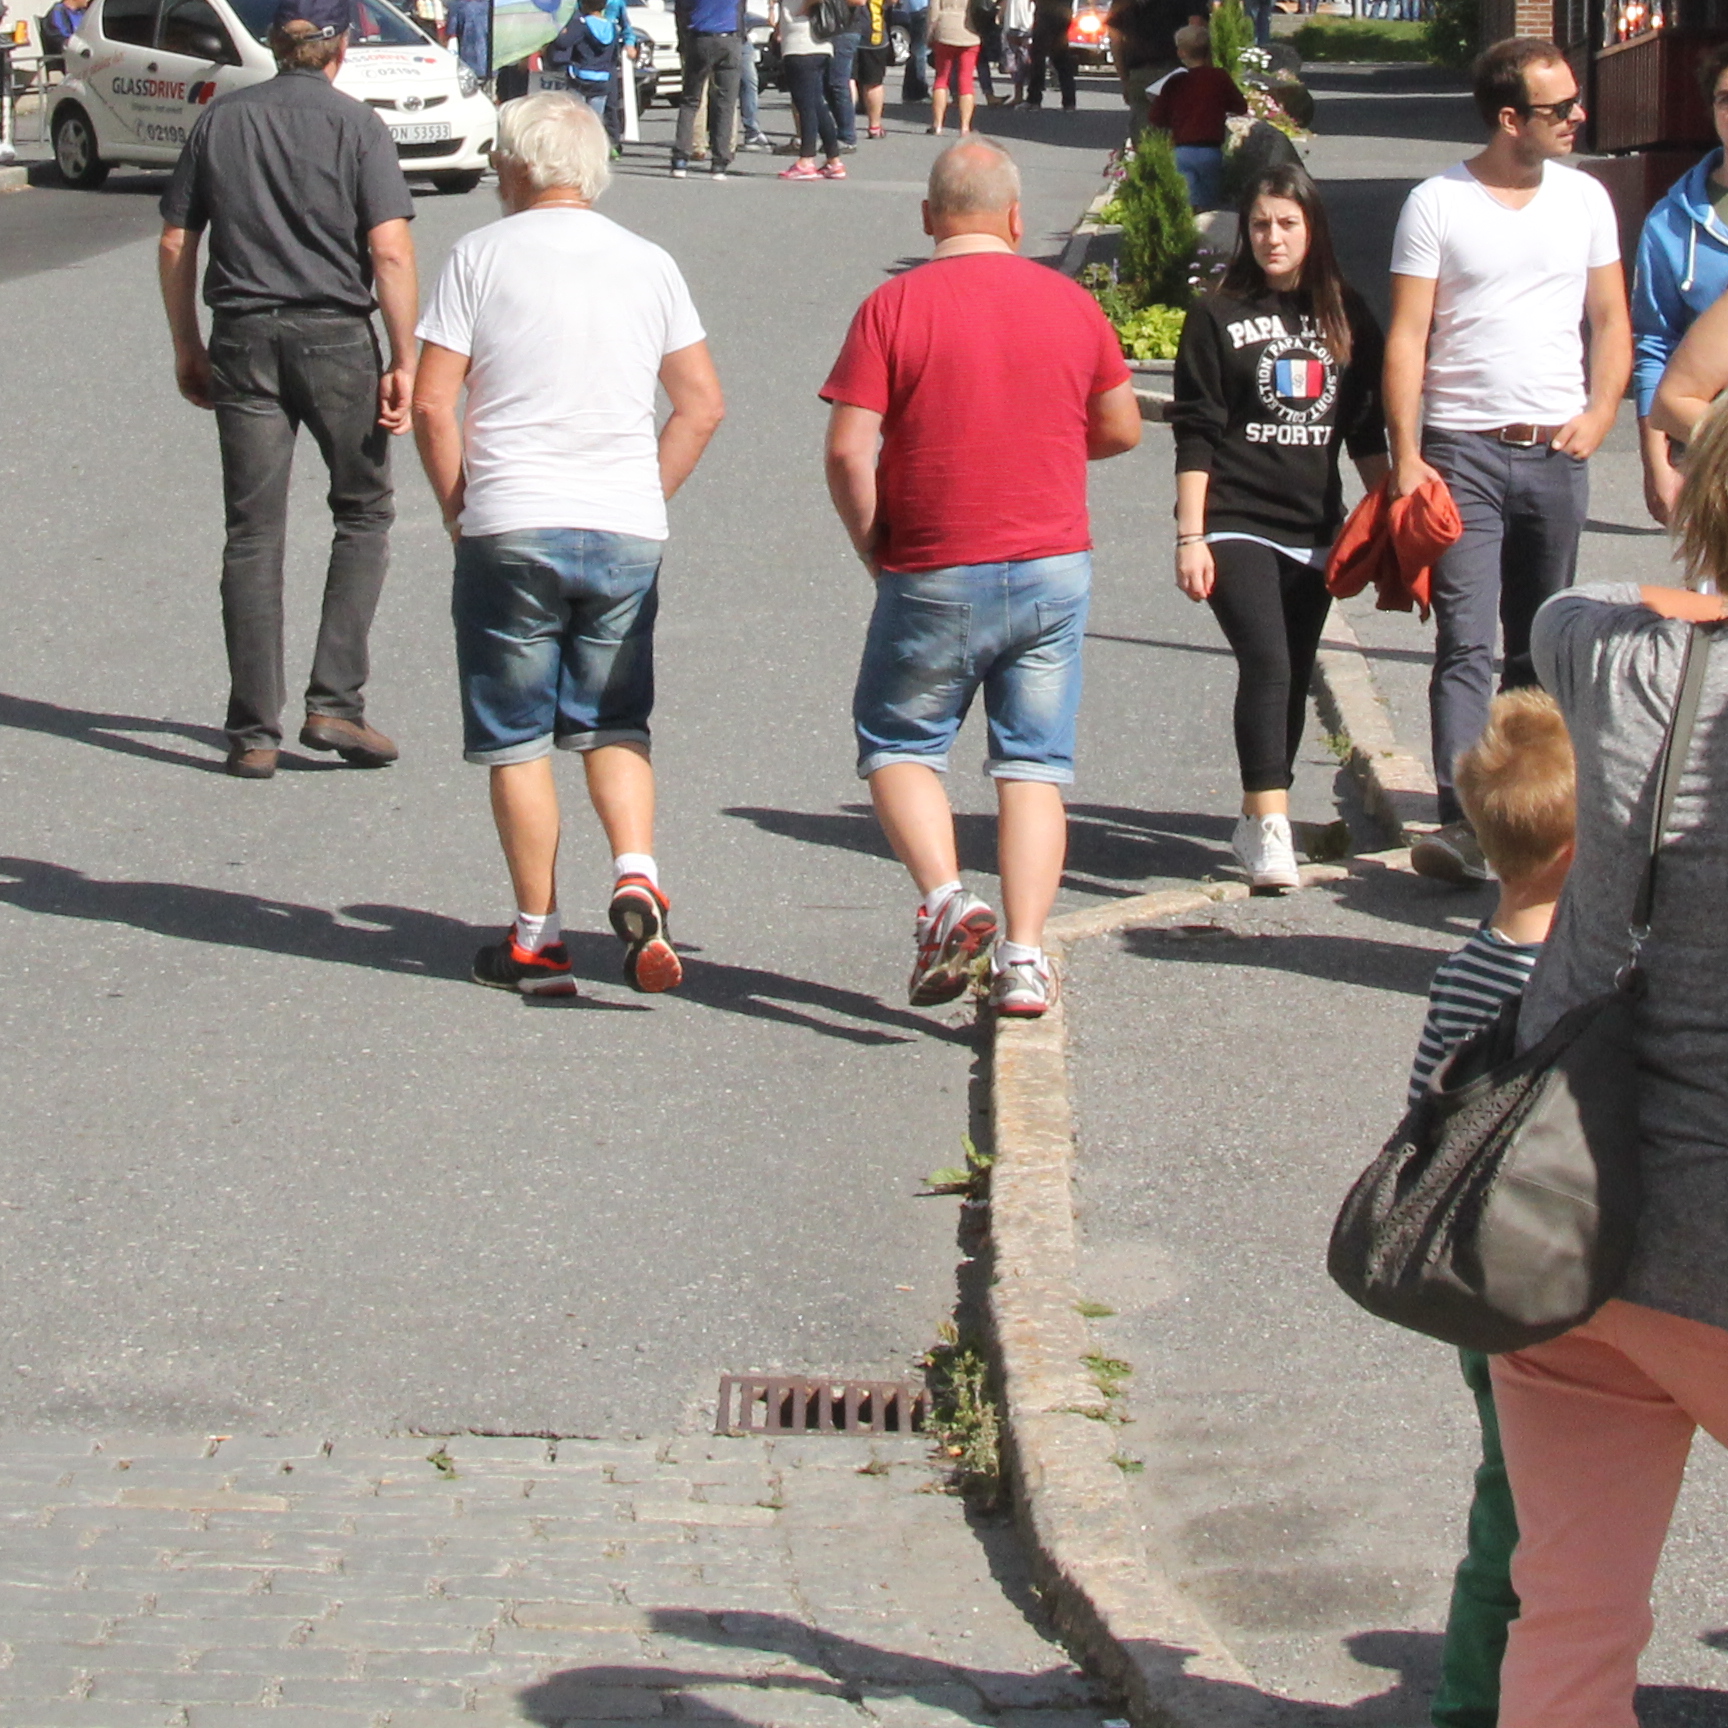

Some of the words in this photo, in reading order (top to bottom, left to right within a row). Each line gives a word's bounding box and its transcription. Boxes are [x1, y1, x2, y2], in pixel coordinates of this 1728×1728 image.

[377, 67, 421, 76] 02199
[112, 76, 186, 100] GLASSDRIVE
[414, 126, 449, 140] 53533
[1227, 315, 1289, 349] PAPA
[1269, 337, 1305, 358] PAPA
[1309, 341, 1334, 367] LOU
[1258, 357, 1307, 423] COLLECTION
[1310, 375, 1338, 420] SPORT
